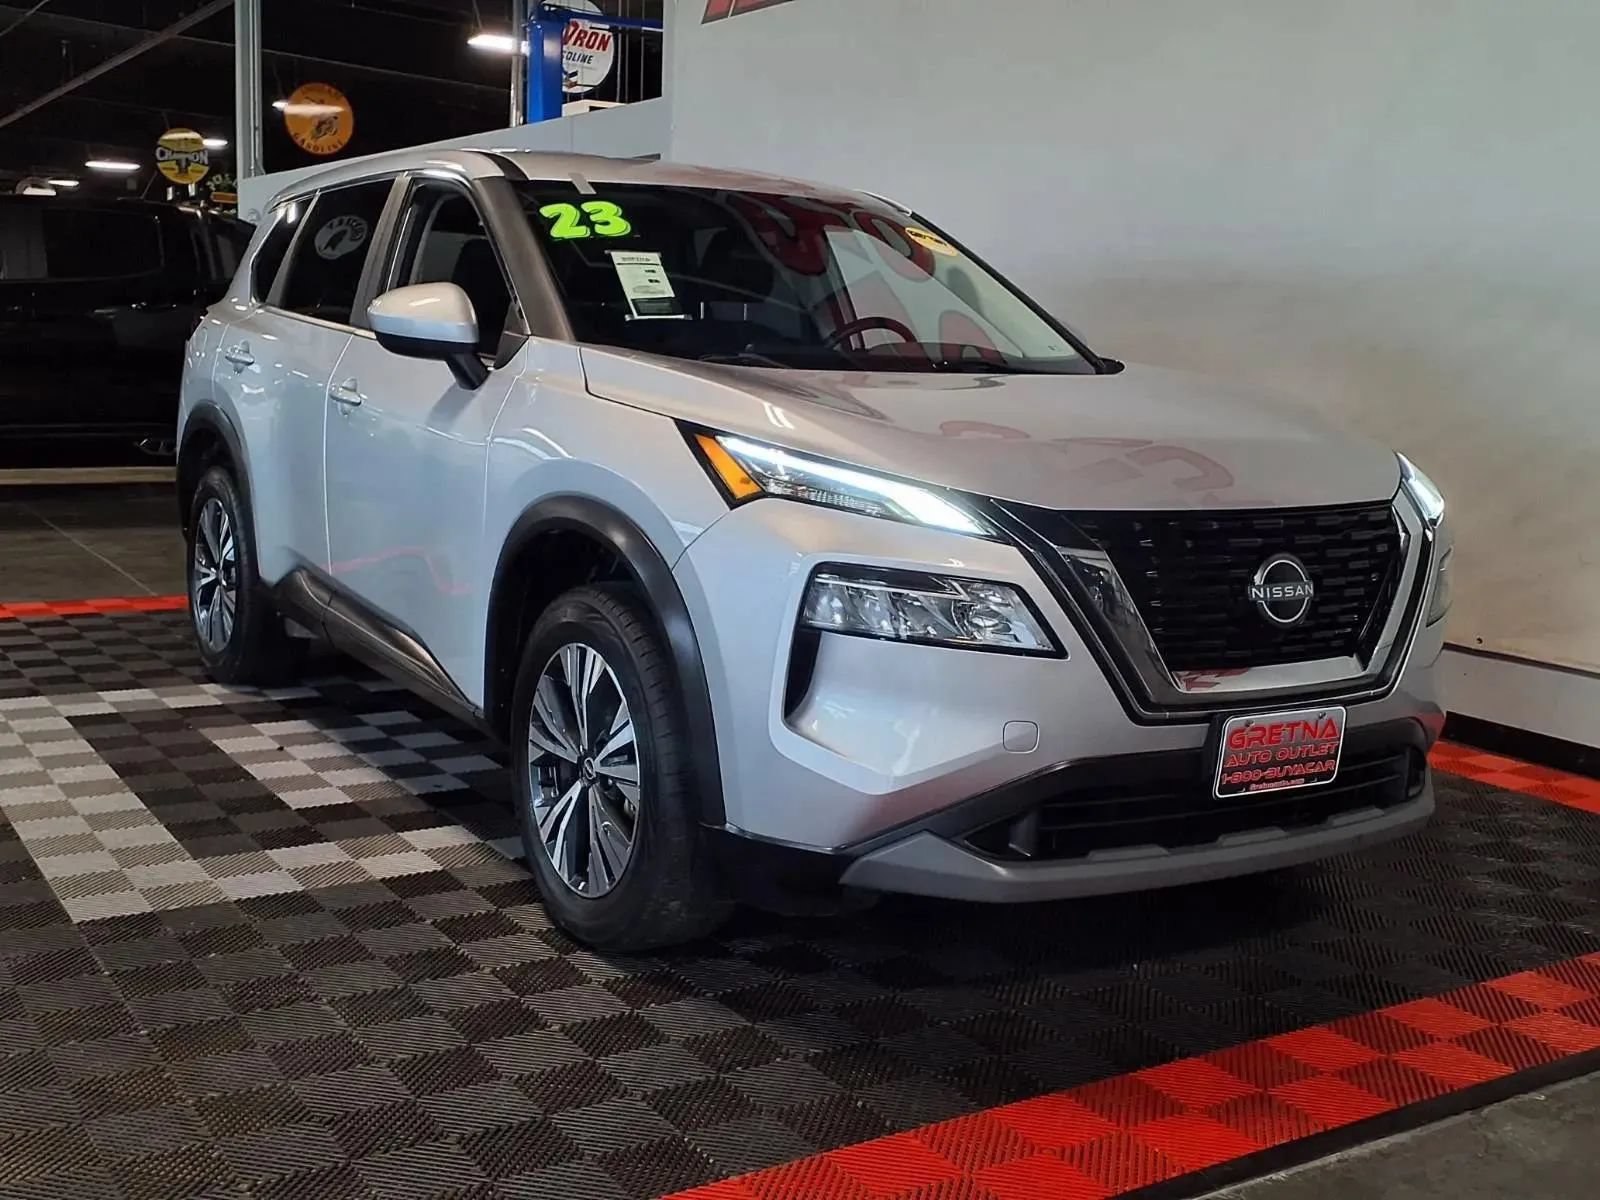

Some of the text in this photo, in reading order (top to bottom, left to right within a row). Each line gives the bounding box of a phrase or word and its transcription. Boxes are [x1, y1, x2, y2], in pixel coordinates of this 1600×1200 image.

[155, 146, 209, 166] CHON
[539, 201, 632, 238] 23
[1251, 583, 1313, 599] NISSAN
[1228, 717, 1339, 750] GRETNA
[1223, 741, 1339, 768] AUTO OUTLET
[1221, 759, 1336, 785] 1-800-BUYACAR
